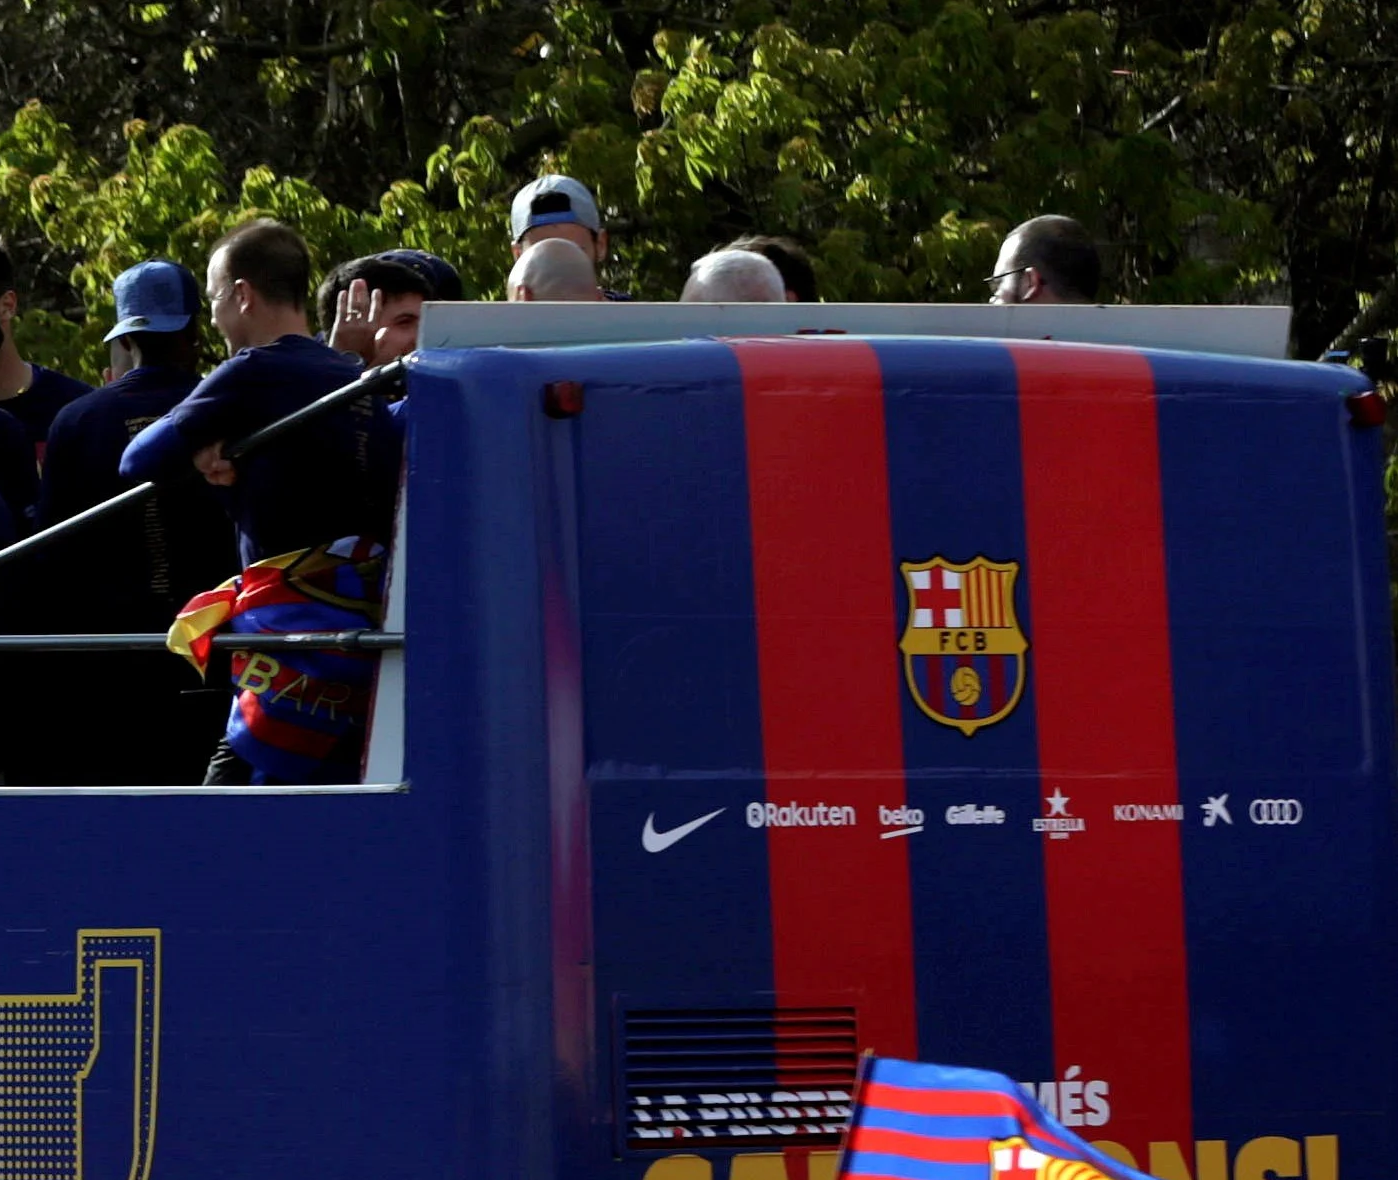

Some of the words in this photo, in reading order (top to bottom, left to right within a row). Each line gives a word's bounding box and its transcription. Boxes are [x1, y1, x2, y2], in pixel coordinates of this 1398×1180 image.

[940, 631, 988, 651] FCB
[764, 801, 857, 827] Rakuten
[878, 805, 925, 826] beko
[945, 804, 1006, 825] Gillette
[1113, 804, 1185, 822] KONAMI
[1033, 818, 1086, 831] ESTRELLA
